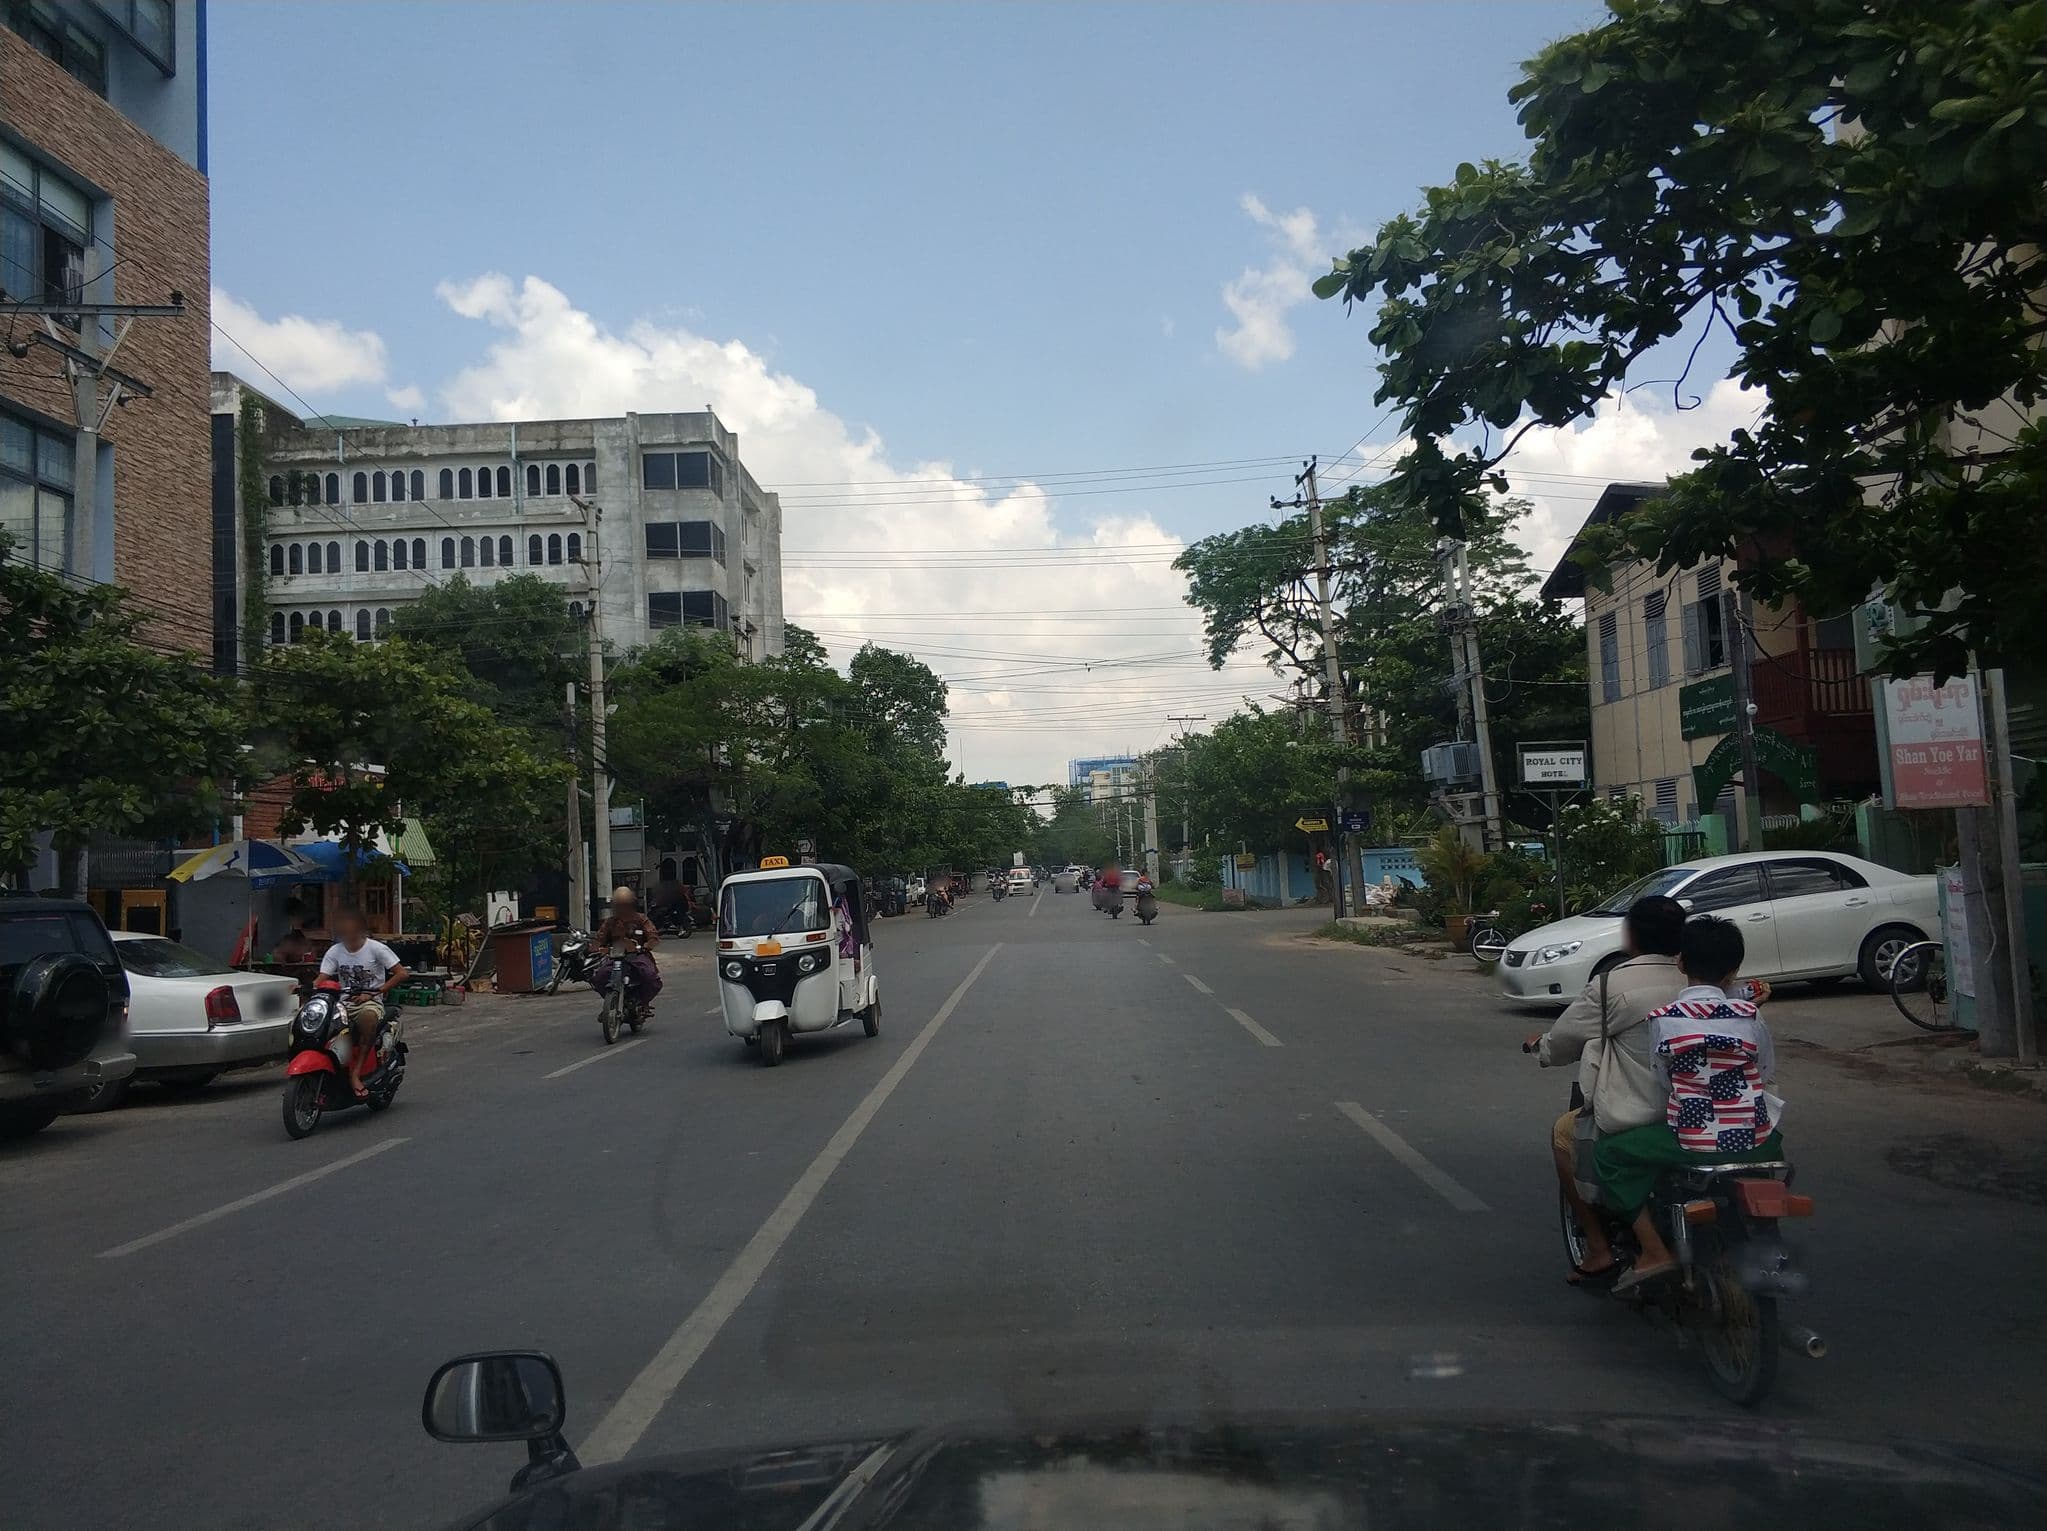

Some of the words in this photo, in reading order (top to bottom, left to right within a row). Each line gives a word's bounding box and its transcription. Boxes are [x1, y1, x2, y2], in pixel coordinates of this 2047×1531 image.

[1895, 748, 1927, 764] Shan
[1928, 746, 1953, 763] Yoe
[1956, 745, 1978, 761] Yar
[1525, 758, 1556, 766] ROYAL
[1560, 757, 1582, 765] CITY
[764, 857, 784, 865] TAXI
